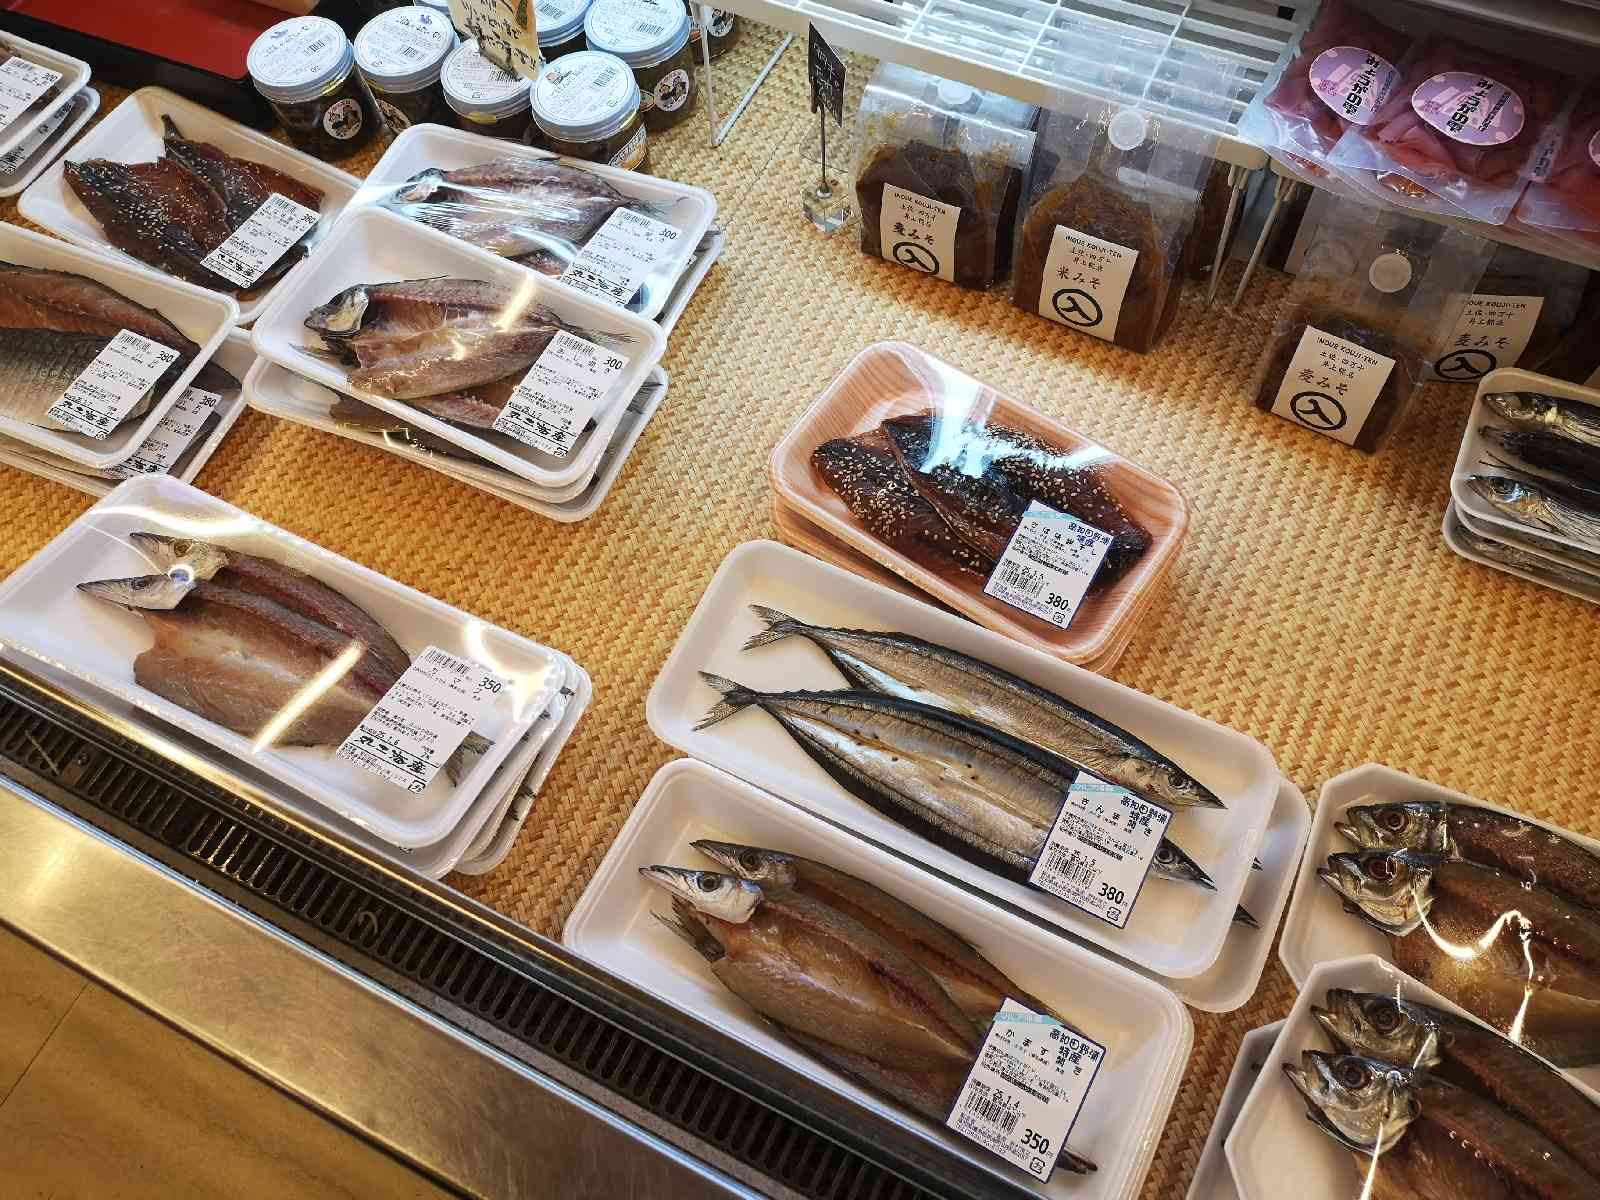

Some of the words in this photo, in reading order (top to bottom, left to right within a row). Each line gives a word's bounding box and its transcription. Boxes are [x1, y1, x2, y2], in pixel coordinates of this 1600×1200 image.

[1057, 265, 1100, 289] 米みそ
[1317, 337, 1338, 349] INOUE
[158, 351, 174, 362] 380
[603, 357, 623, 370] 300
[1299, 368, 1348, 396] 麦みそ
[478, 677, 501, 693] 350
[1006, 1029, 1082, 1075] かます開き
